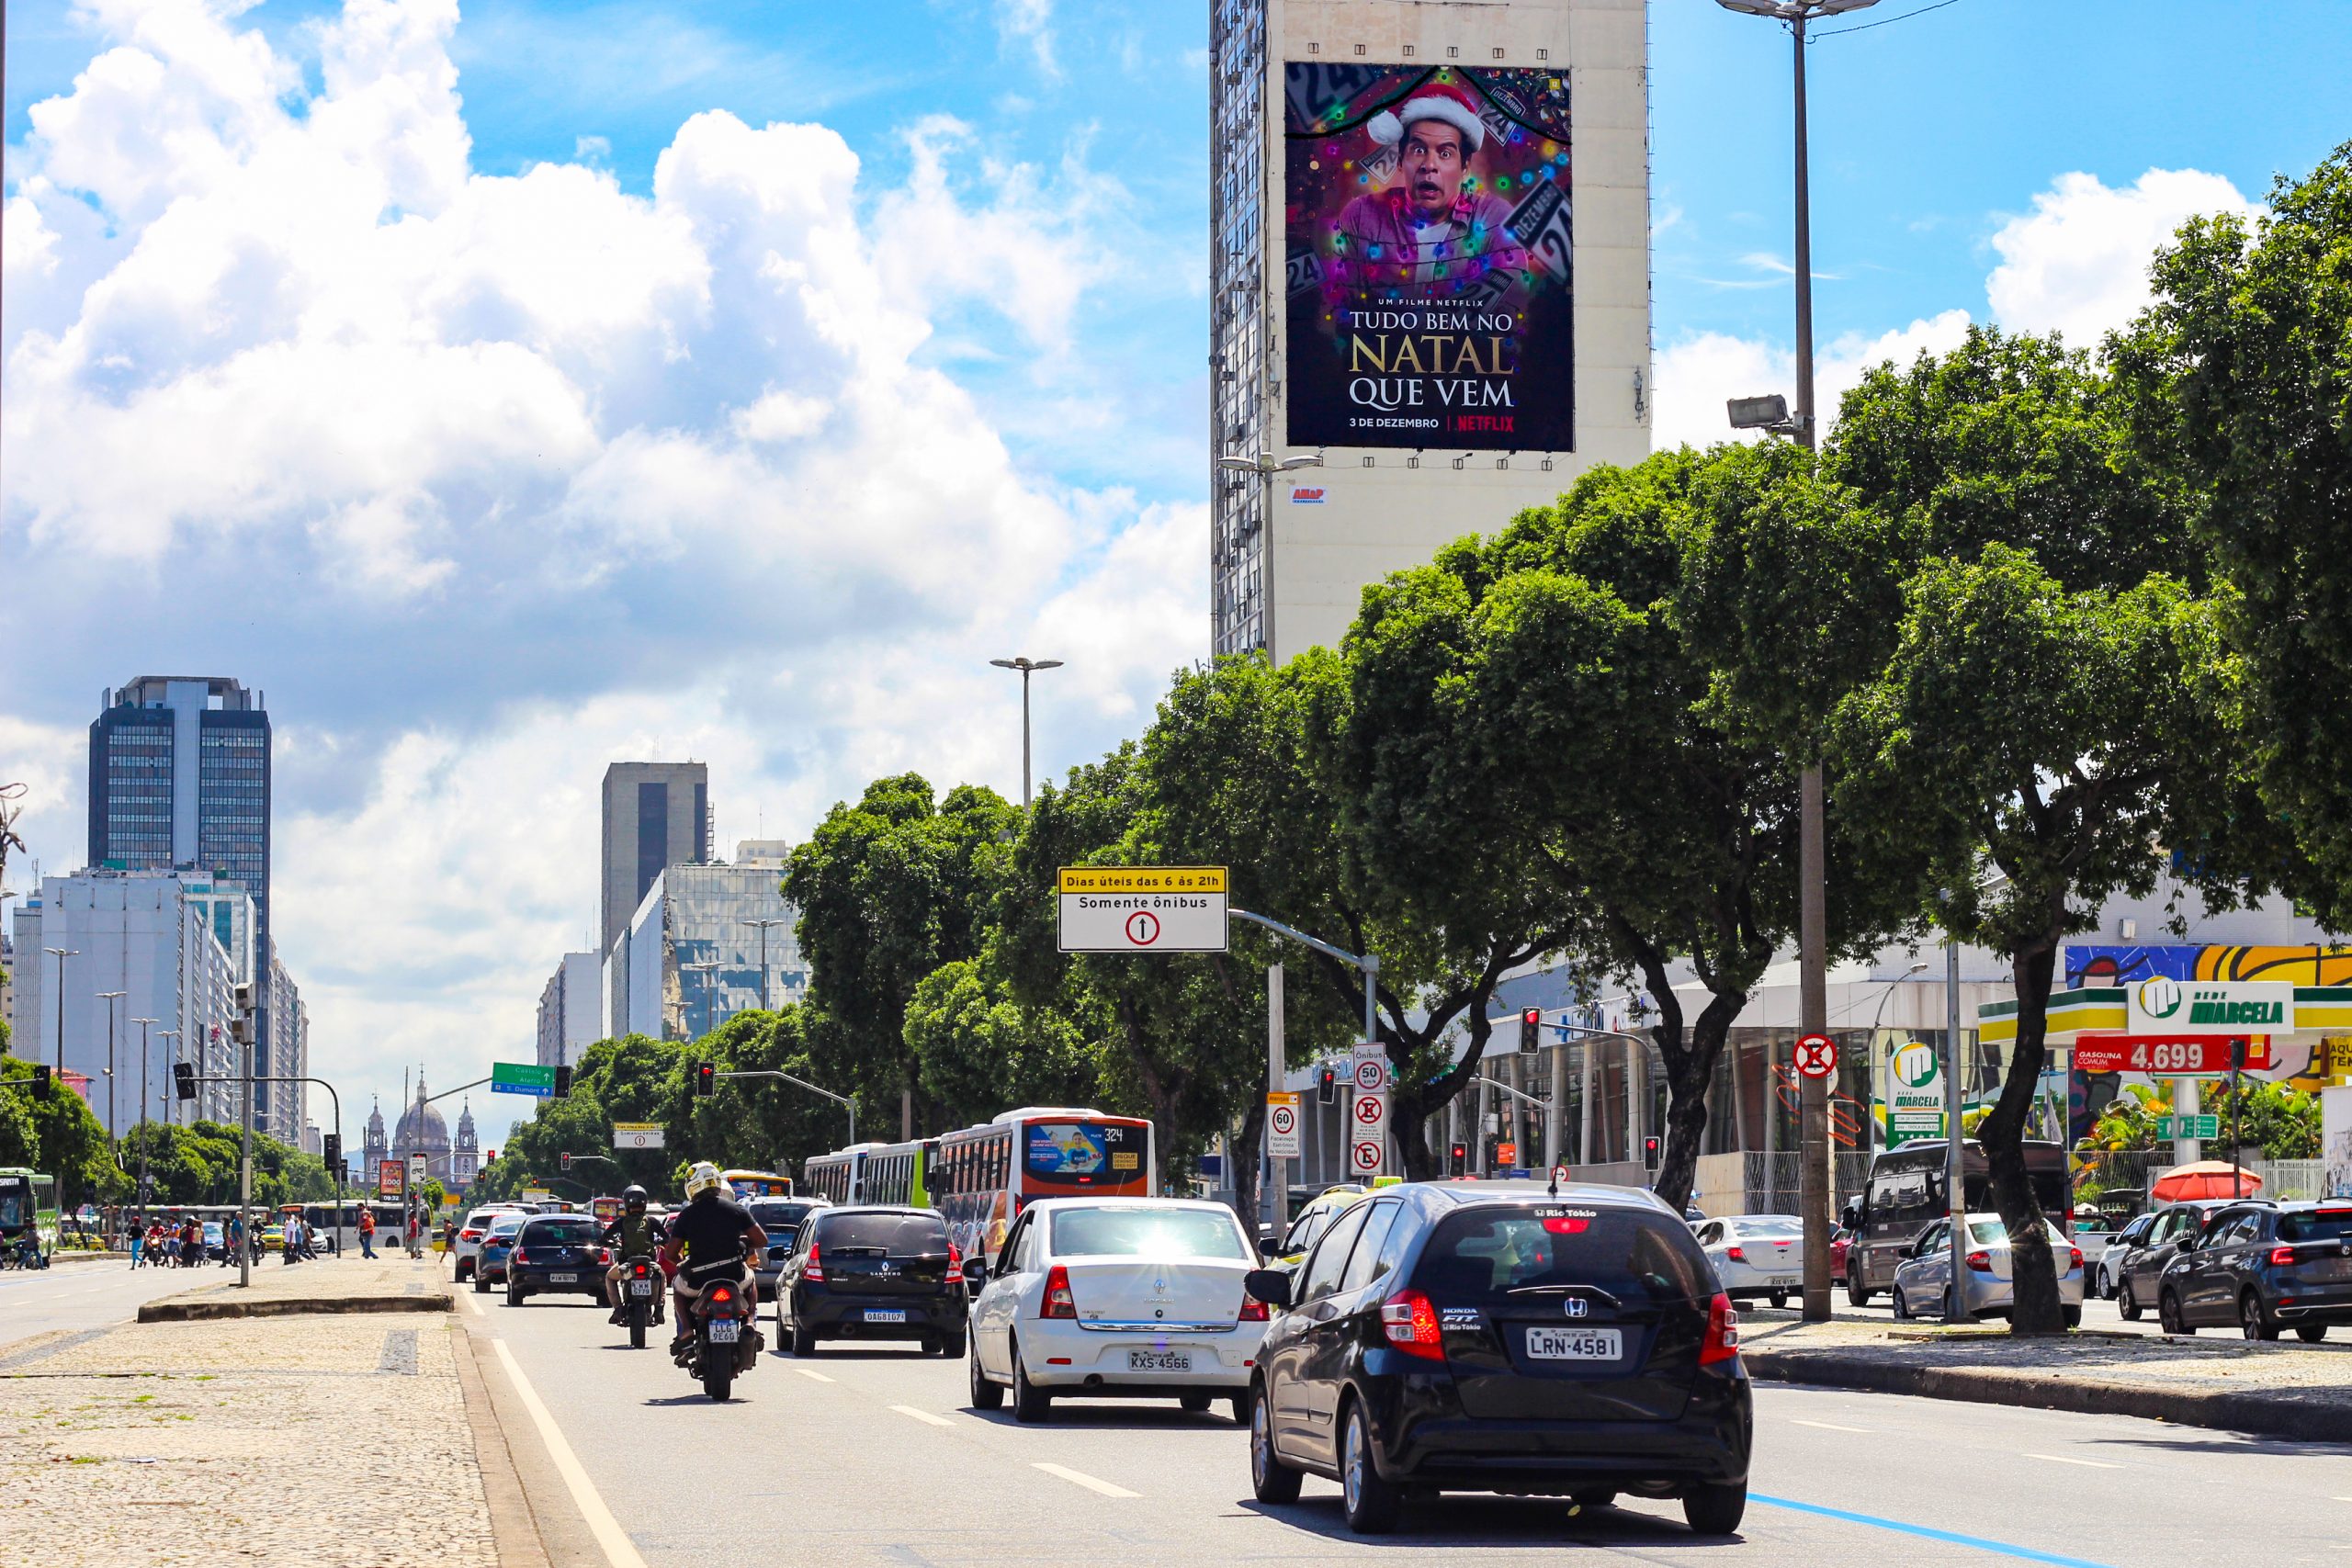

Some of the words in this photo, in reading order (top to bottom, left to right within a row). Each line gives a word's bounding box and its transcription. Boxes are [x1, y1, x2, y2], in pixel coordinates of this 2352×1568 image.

[1493, 90, 1522, 115] DEZEMBRO
[1480, 107, 1512, 137] 24
[1349, 310, 1418, 330] TUDO
[1426, 312, 1470, 331] BEM
[1476, 313, 1513, 332] NO
[1349, 333, 1514, 375] NATAL
[1349, 378, 1424, 412] QUE
[1433, 378, 1515, 408] VEM
[1349, 418, 1356, 427] 3
[1359, 418, 1374, 427] DE
[1376, 418, 1439, 428] DEZEMBRO
[1457, 415, 1514, 433] NETFLIX
[1067, 876, 1094, 886] Dias
[1100, 875, 1132, 886] úteis
[1136, 876, 1159, 886] das
[1165, 876, 1172, 886] 6
[1179, 875, 1193, 886] às
[1198, 876, 1219, 886] 21h
[1079, 897, 1148, 908] Somente
[1153, 896, 1207, 908] ônibus
[2194, 991, 2227, 999] REDE
[1355, 1051, 1383, 1059] Ônibus
[2078, 1051, 2122, 1059] GASOLINA
[2131, 1043, 2203, 1069] 4,699
[2077, 1057, 2109, 1066] COMUM
[1362, 1067, 1377, 1078] 50
[514, 1086, 540, 1094] Dumont
[1276, 1113, 1289, 1124] 60
[1104, 1128, 1123, 1142] 324
